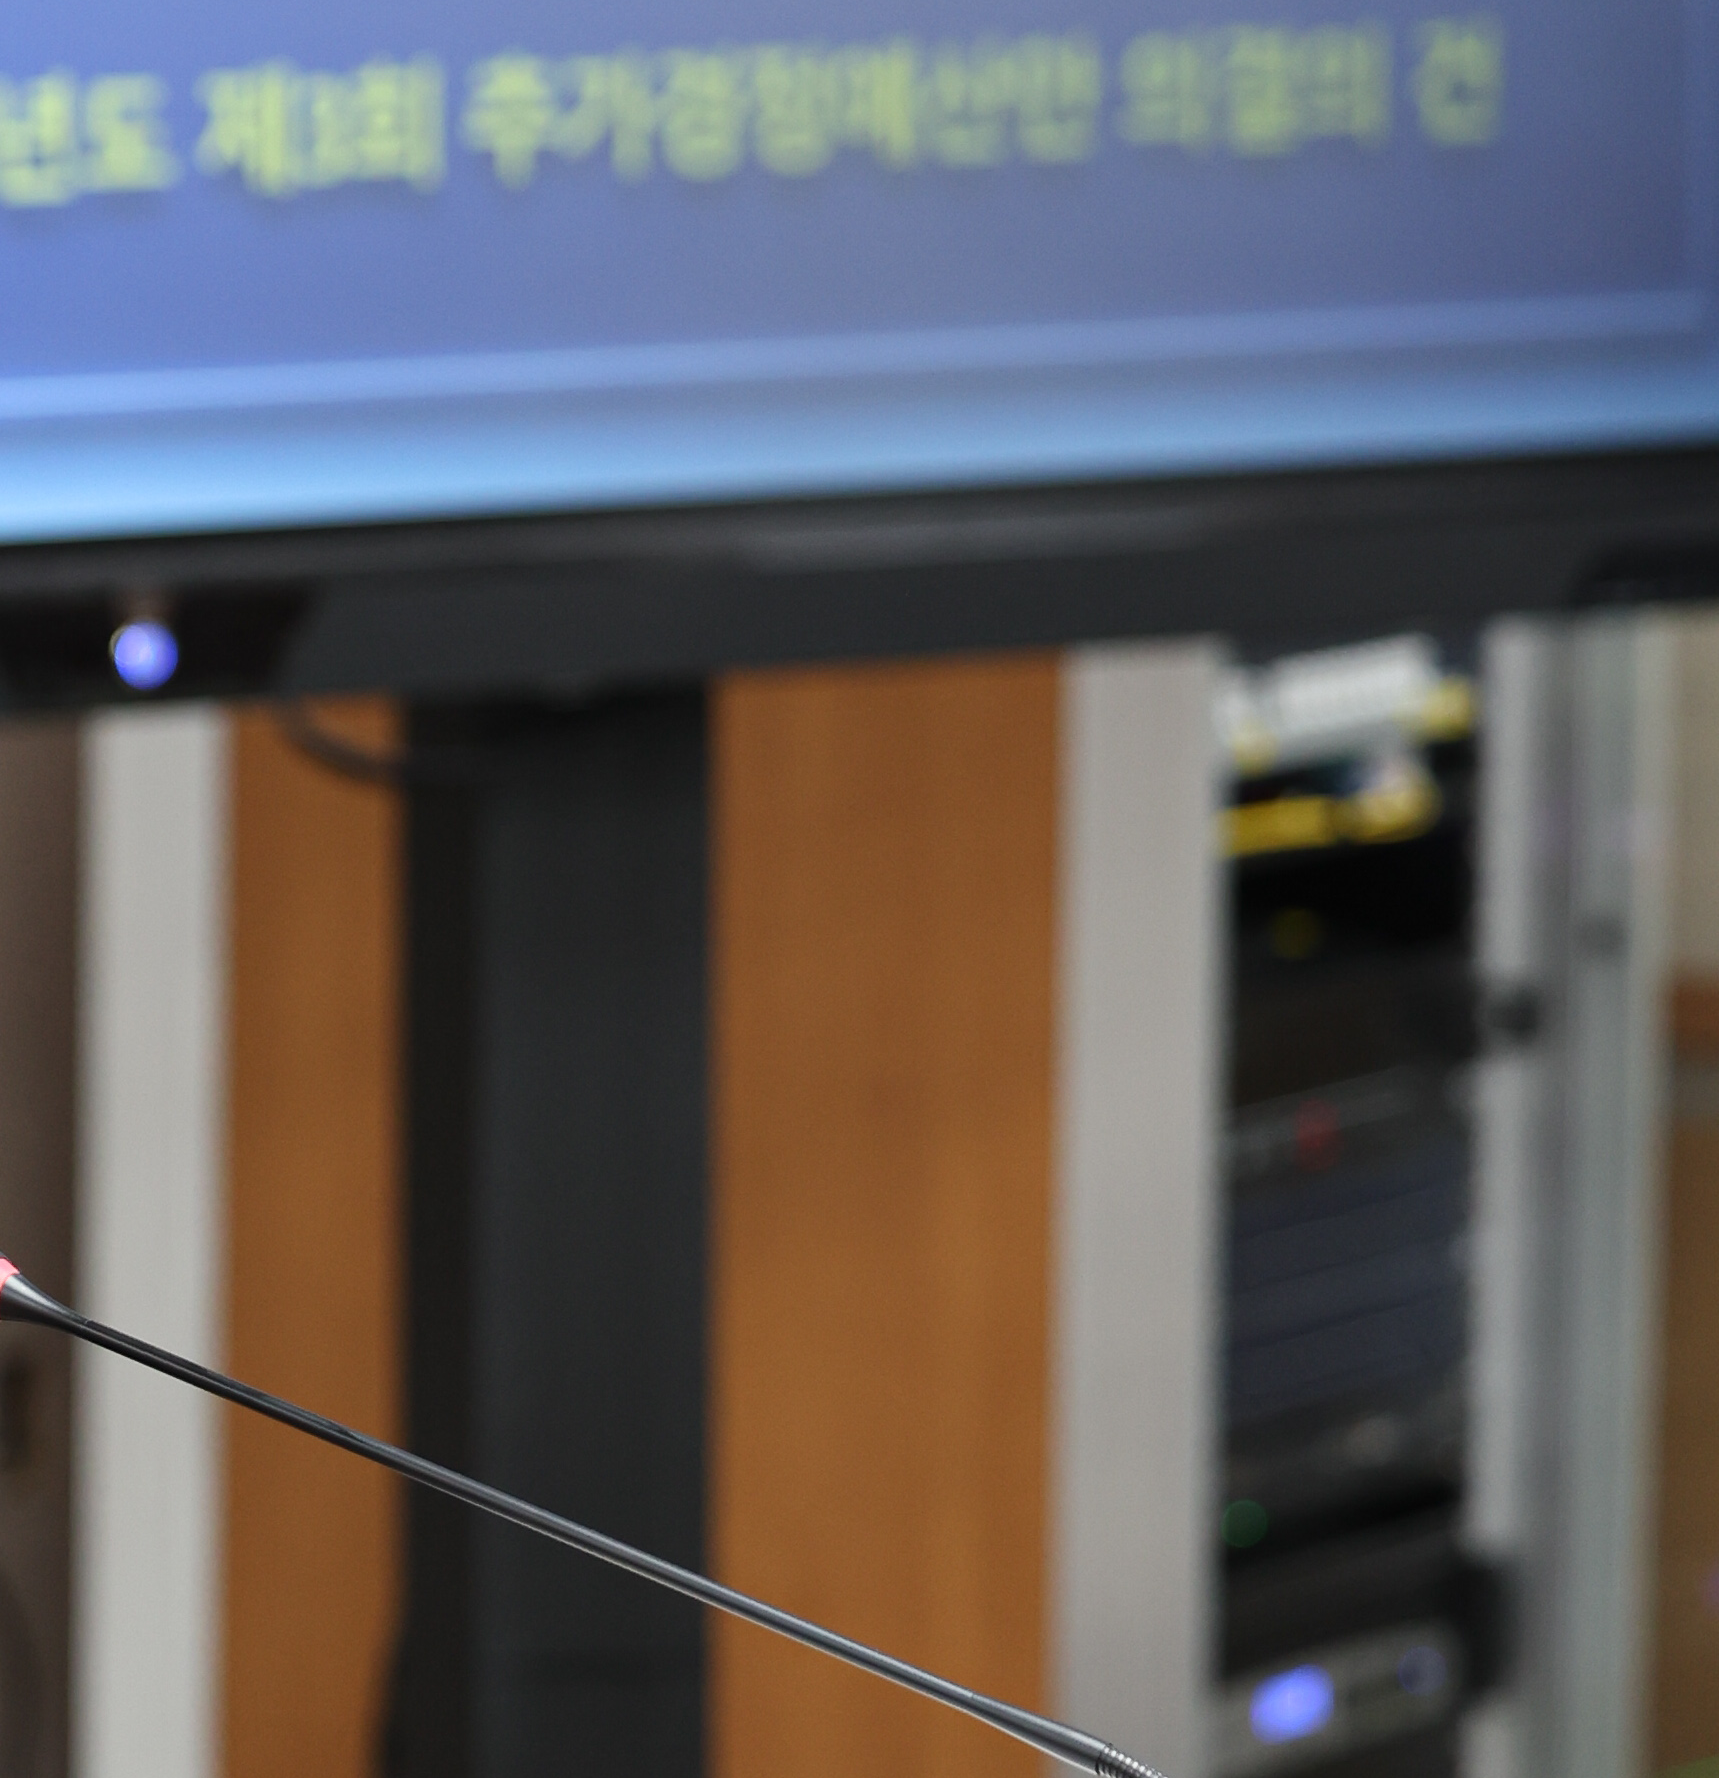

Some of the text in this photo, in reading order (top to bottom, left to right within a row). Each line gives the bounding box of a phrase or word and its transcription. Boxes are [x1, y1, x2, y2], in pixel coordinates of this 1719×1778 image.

[467, 38, 1097, 185] 추가경정예산안
[1121, 31, 1390, 157] 의결의
[1420, 28, 1500, 144] 건
